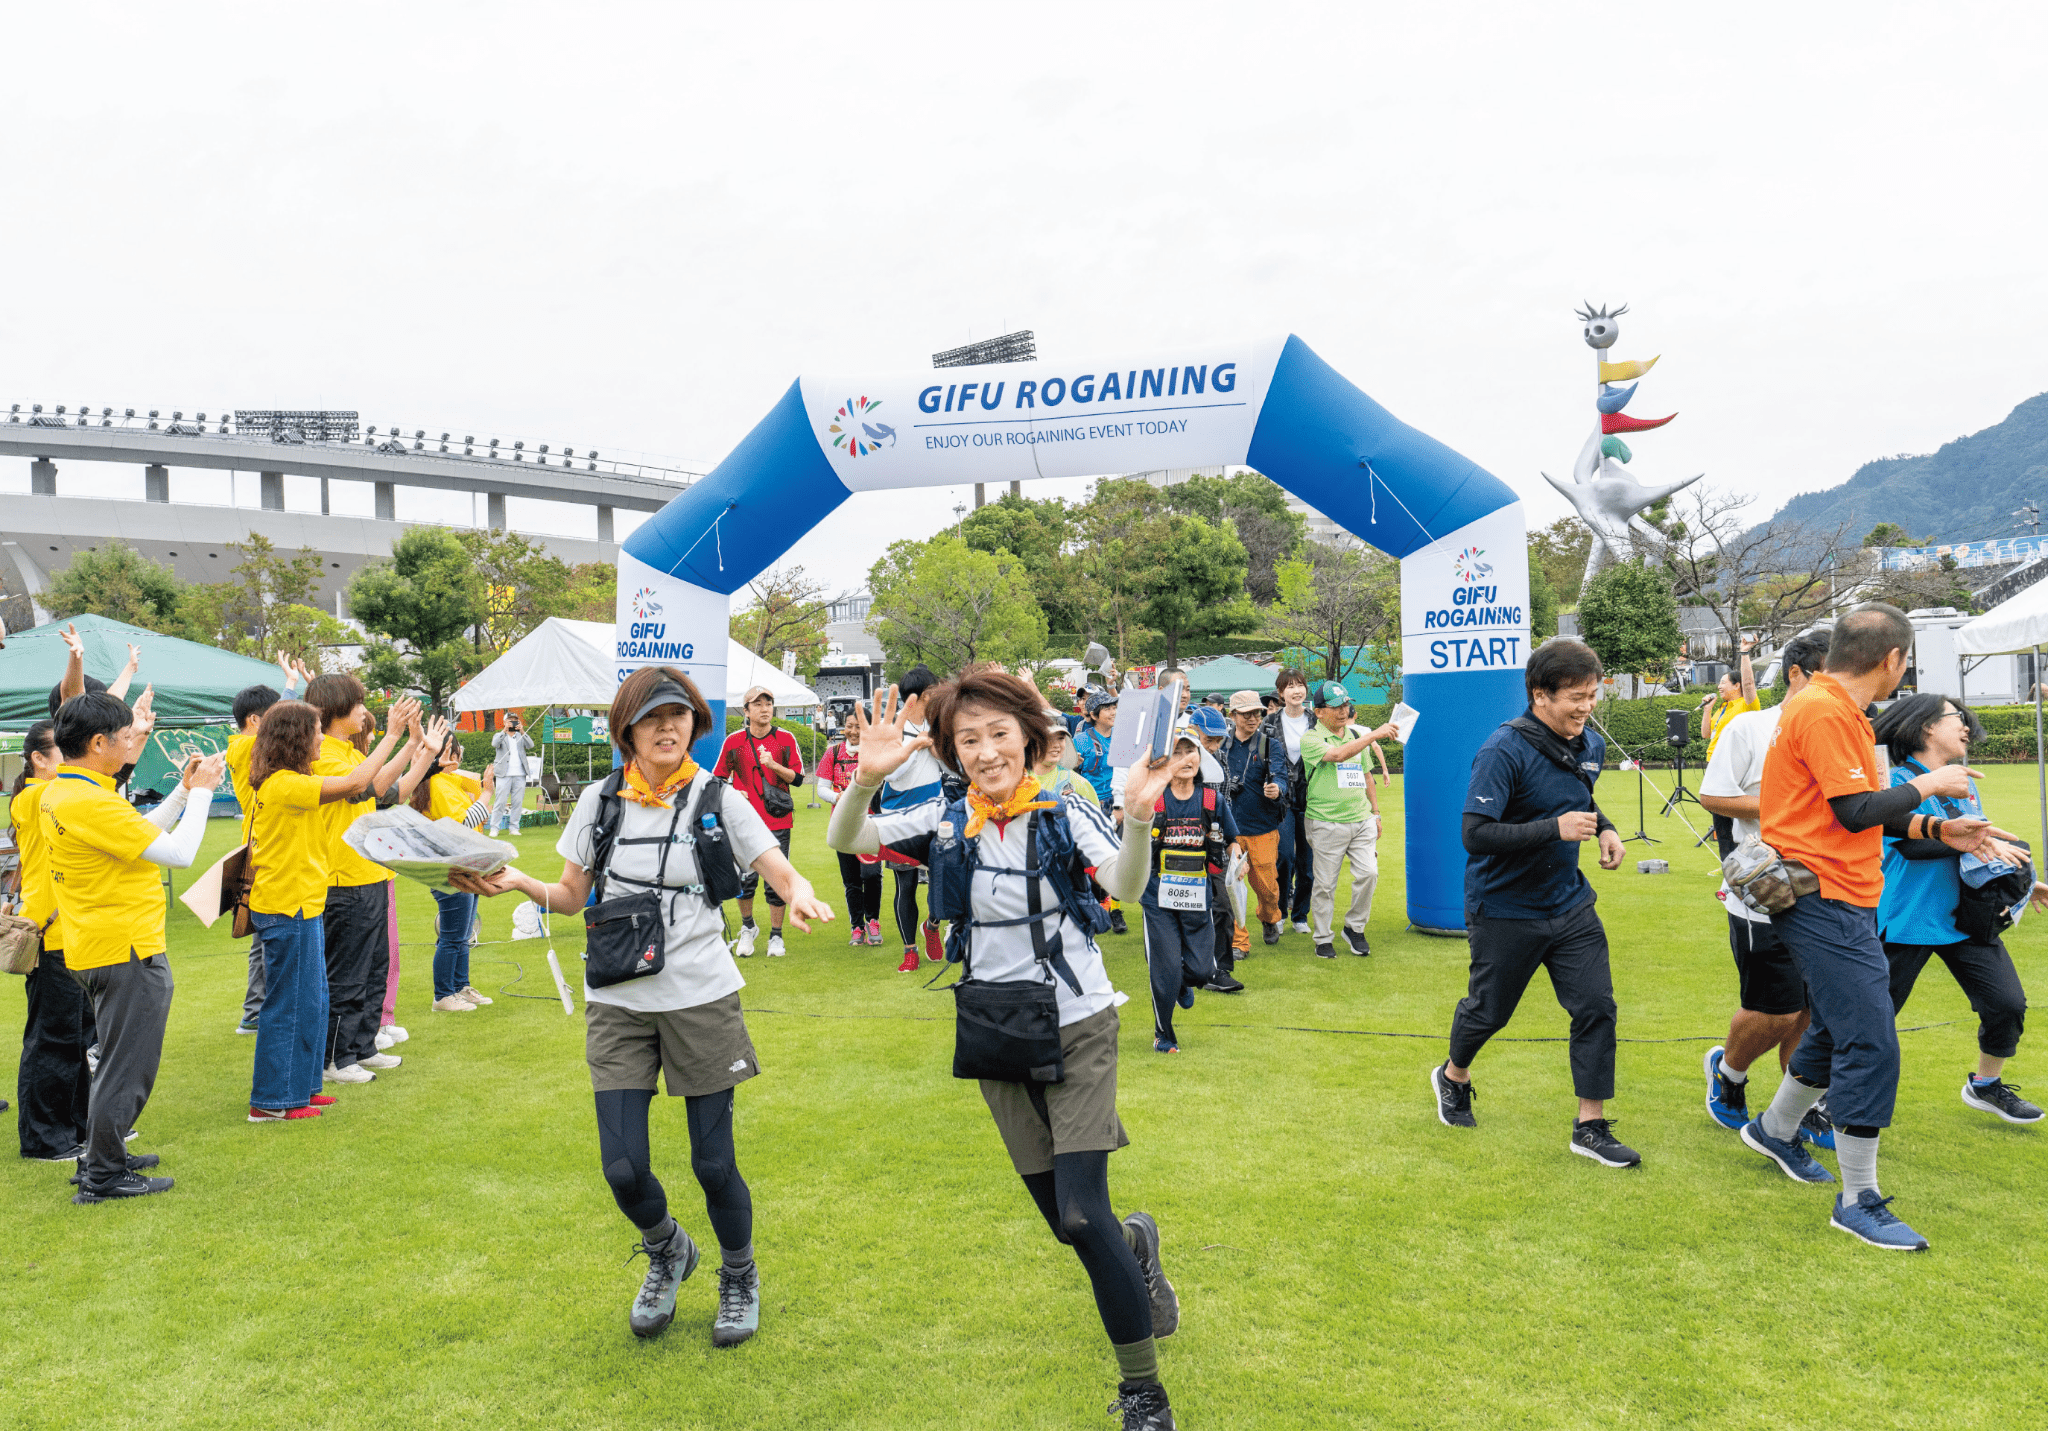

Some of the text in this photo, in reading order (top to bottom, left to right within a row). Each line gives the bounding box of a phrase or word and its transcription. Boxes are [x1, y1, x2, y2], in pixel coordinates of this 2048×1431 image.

[918, 362, 1237, 414] GIFU ROGAINING
[925, 418, 1188, 450] ENJOY OUR ROGAINING EVENT TODAY
[1452, 585, 1498, 606] GIFU
[1424, 605, 1522, 629] ROGAINING
[630, 622, 666, 640] GIFU
[617, 641, 694, 660] ROGAINING
[1430, 637, 1521, 669] START
